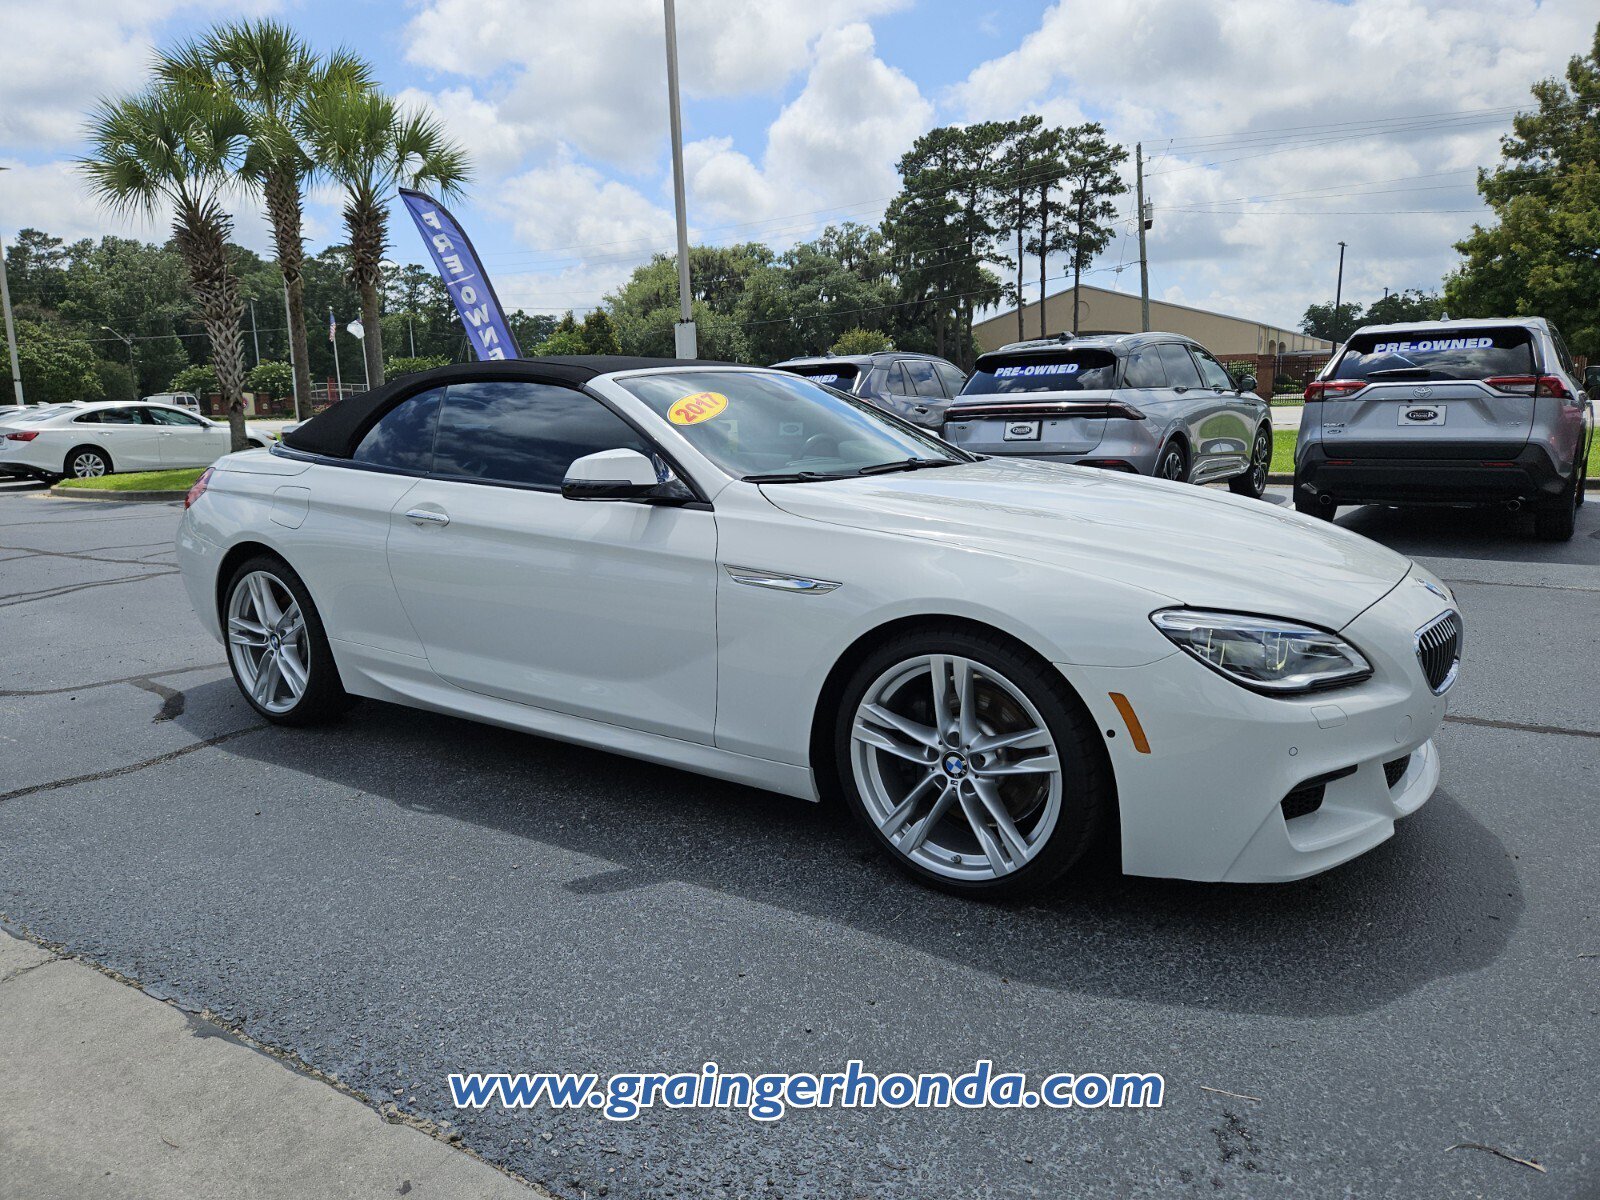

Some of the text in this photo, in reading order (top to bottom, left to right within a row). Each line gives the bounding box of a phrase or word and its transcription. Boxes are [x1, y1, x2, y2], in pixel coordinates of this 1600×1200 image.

[1373, 338, 1493, 353] PRE-OWNED
[994, 364, 1079, 378] PRE-OWNED
[674, 394, 720, 423] 2017
